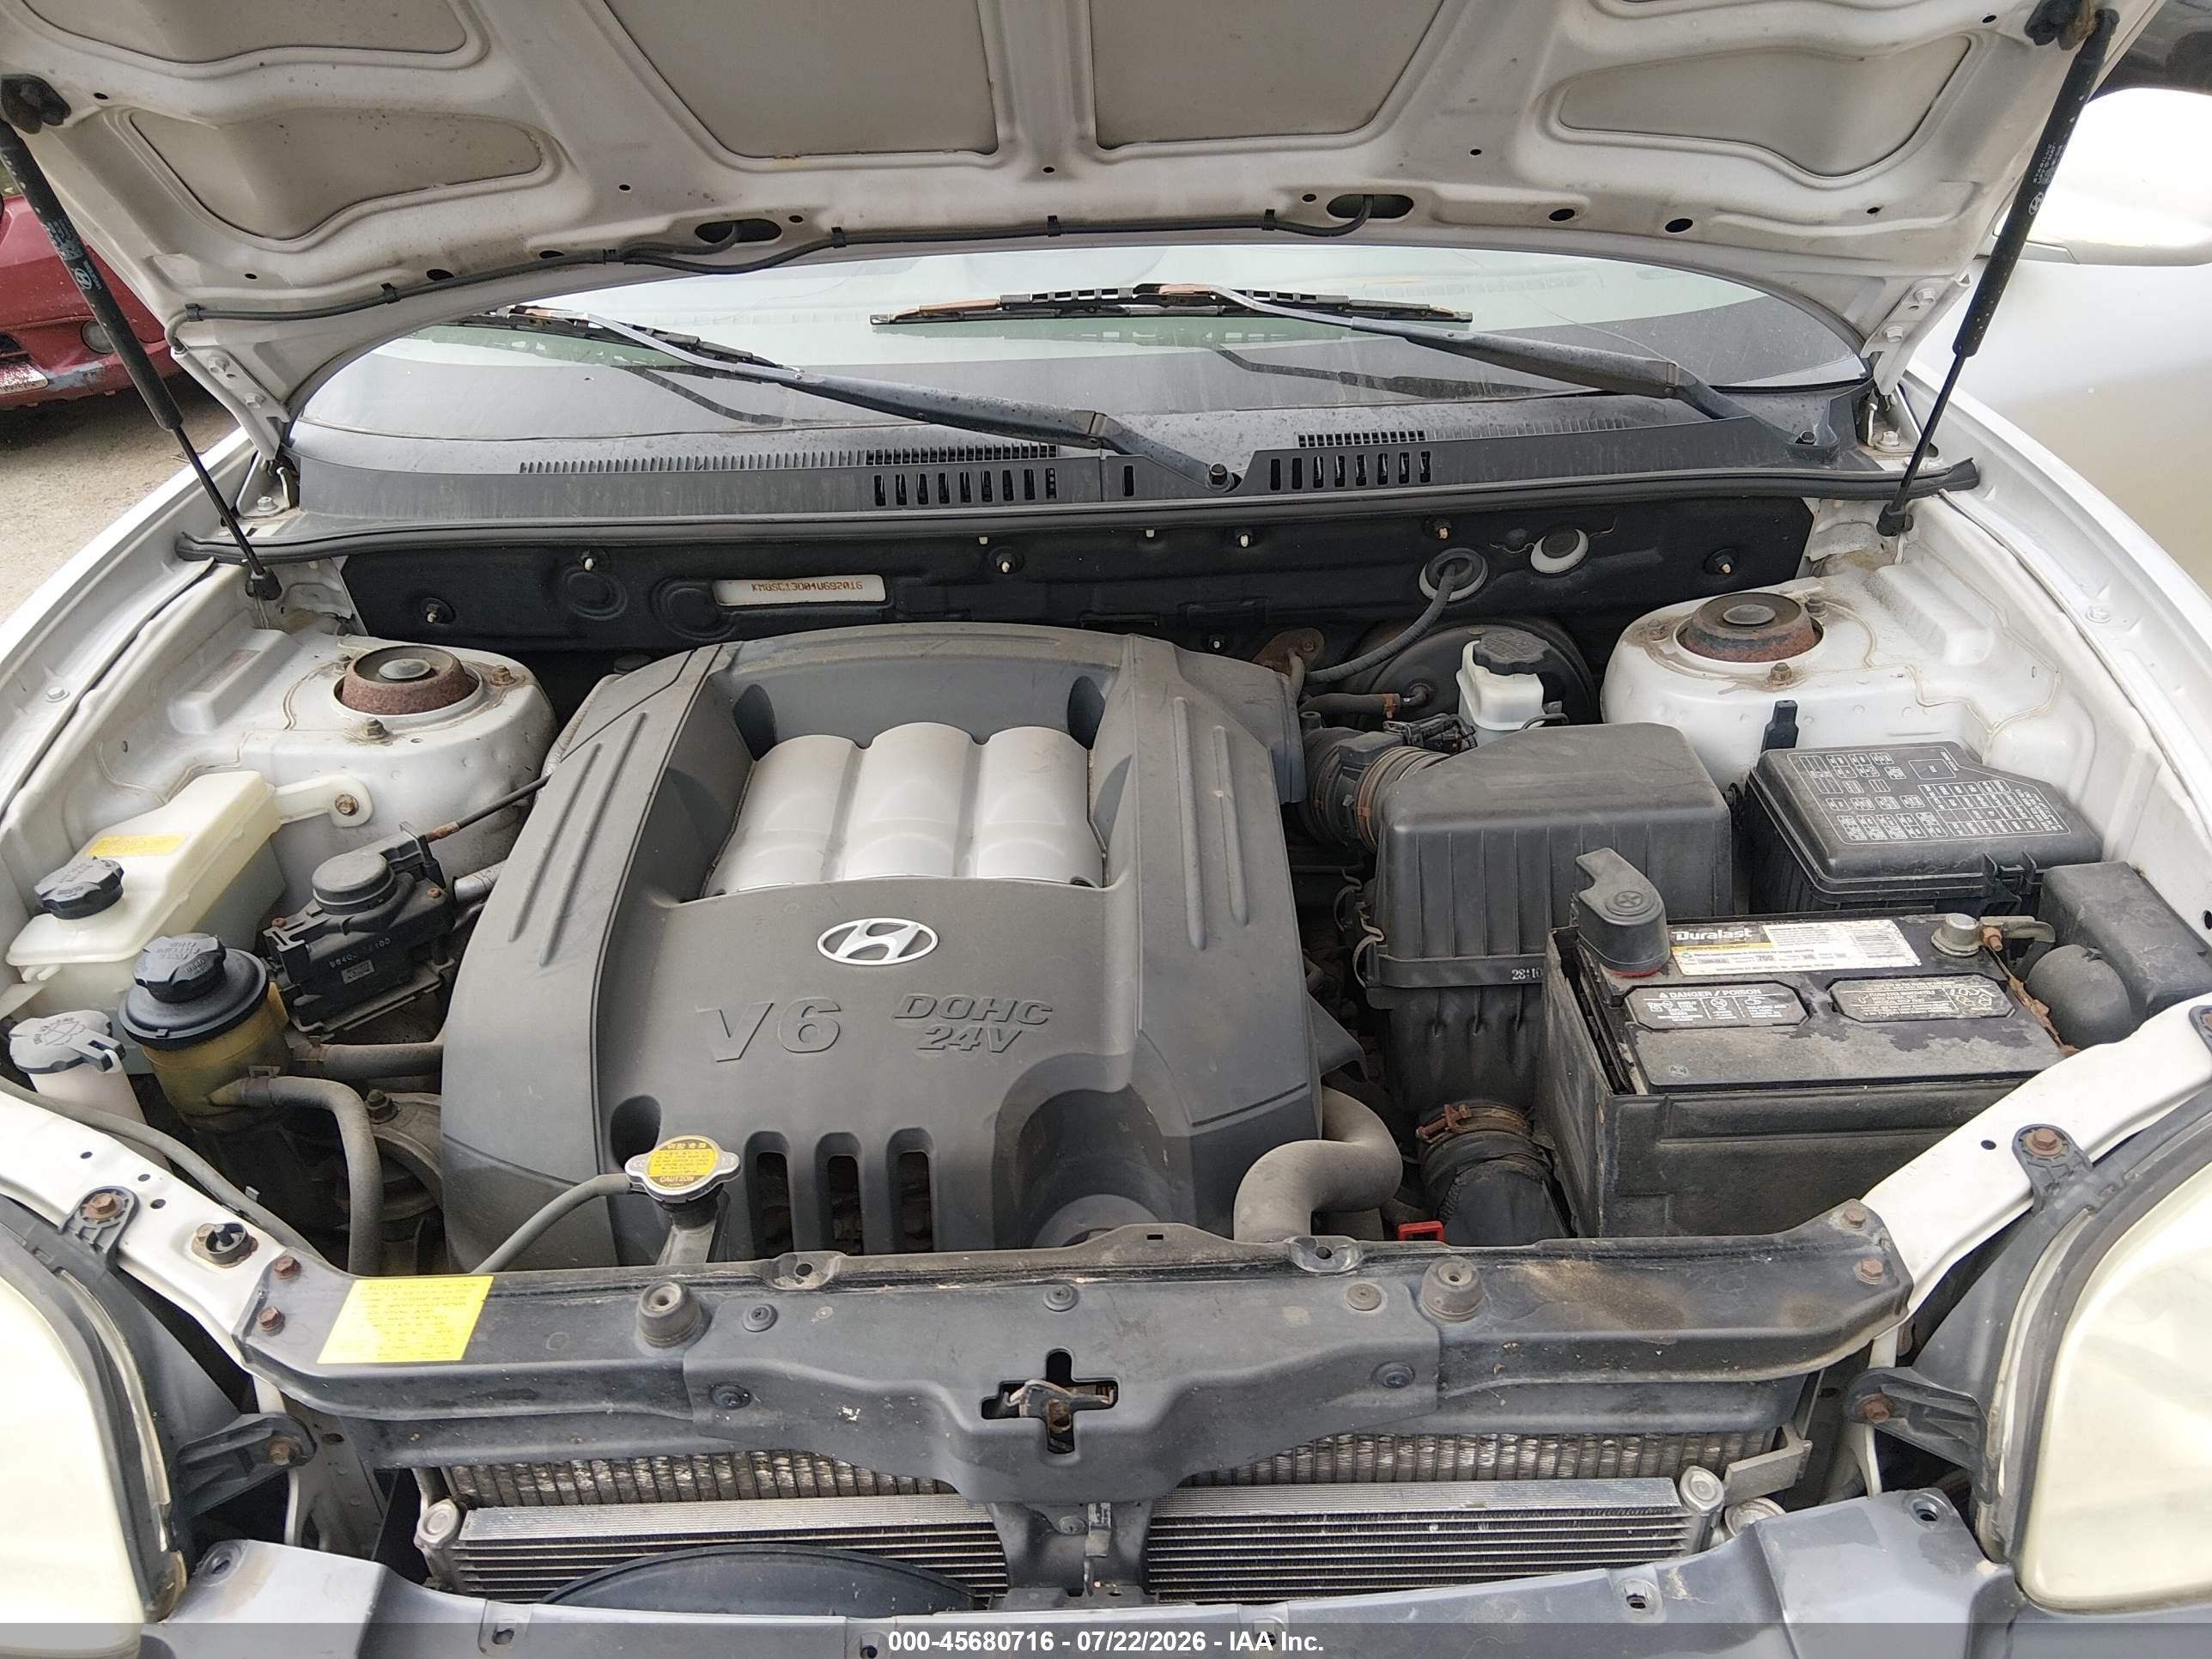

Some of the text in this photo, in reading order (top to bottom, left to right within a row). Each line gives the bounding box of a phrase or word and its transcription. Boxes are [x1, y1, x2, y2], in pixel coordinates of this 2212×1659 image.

[1670, 927, 1753, 941] Duralast
[894, 994, 1054, 1025] DOHC
[696, 996, 842, 1062] V6
[918, 1024, 1023, 1054] 24V
